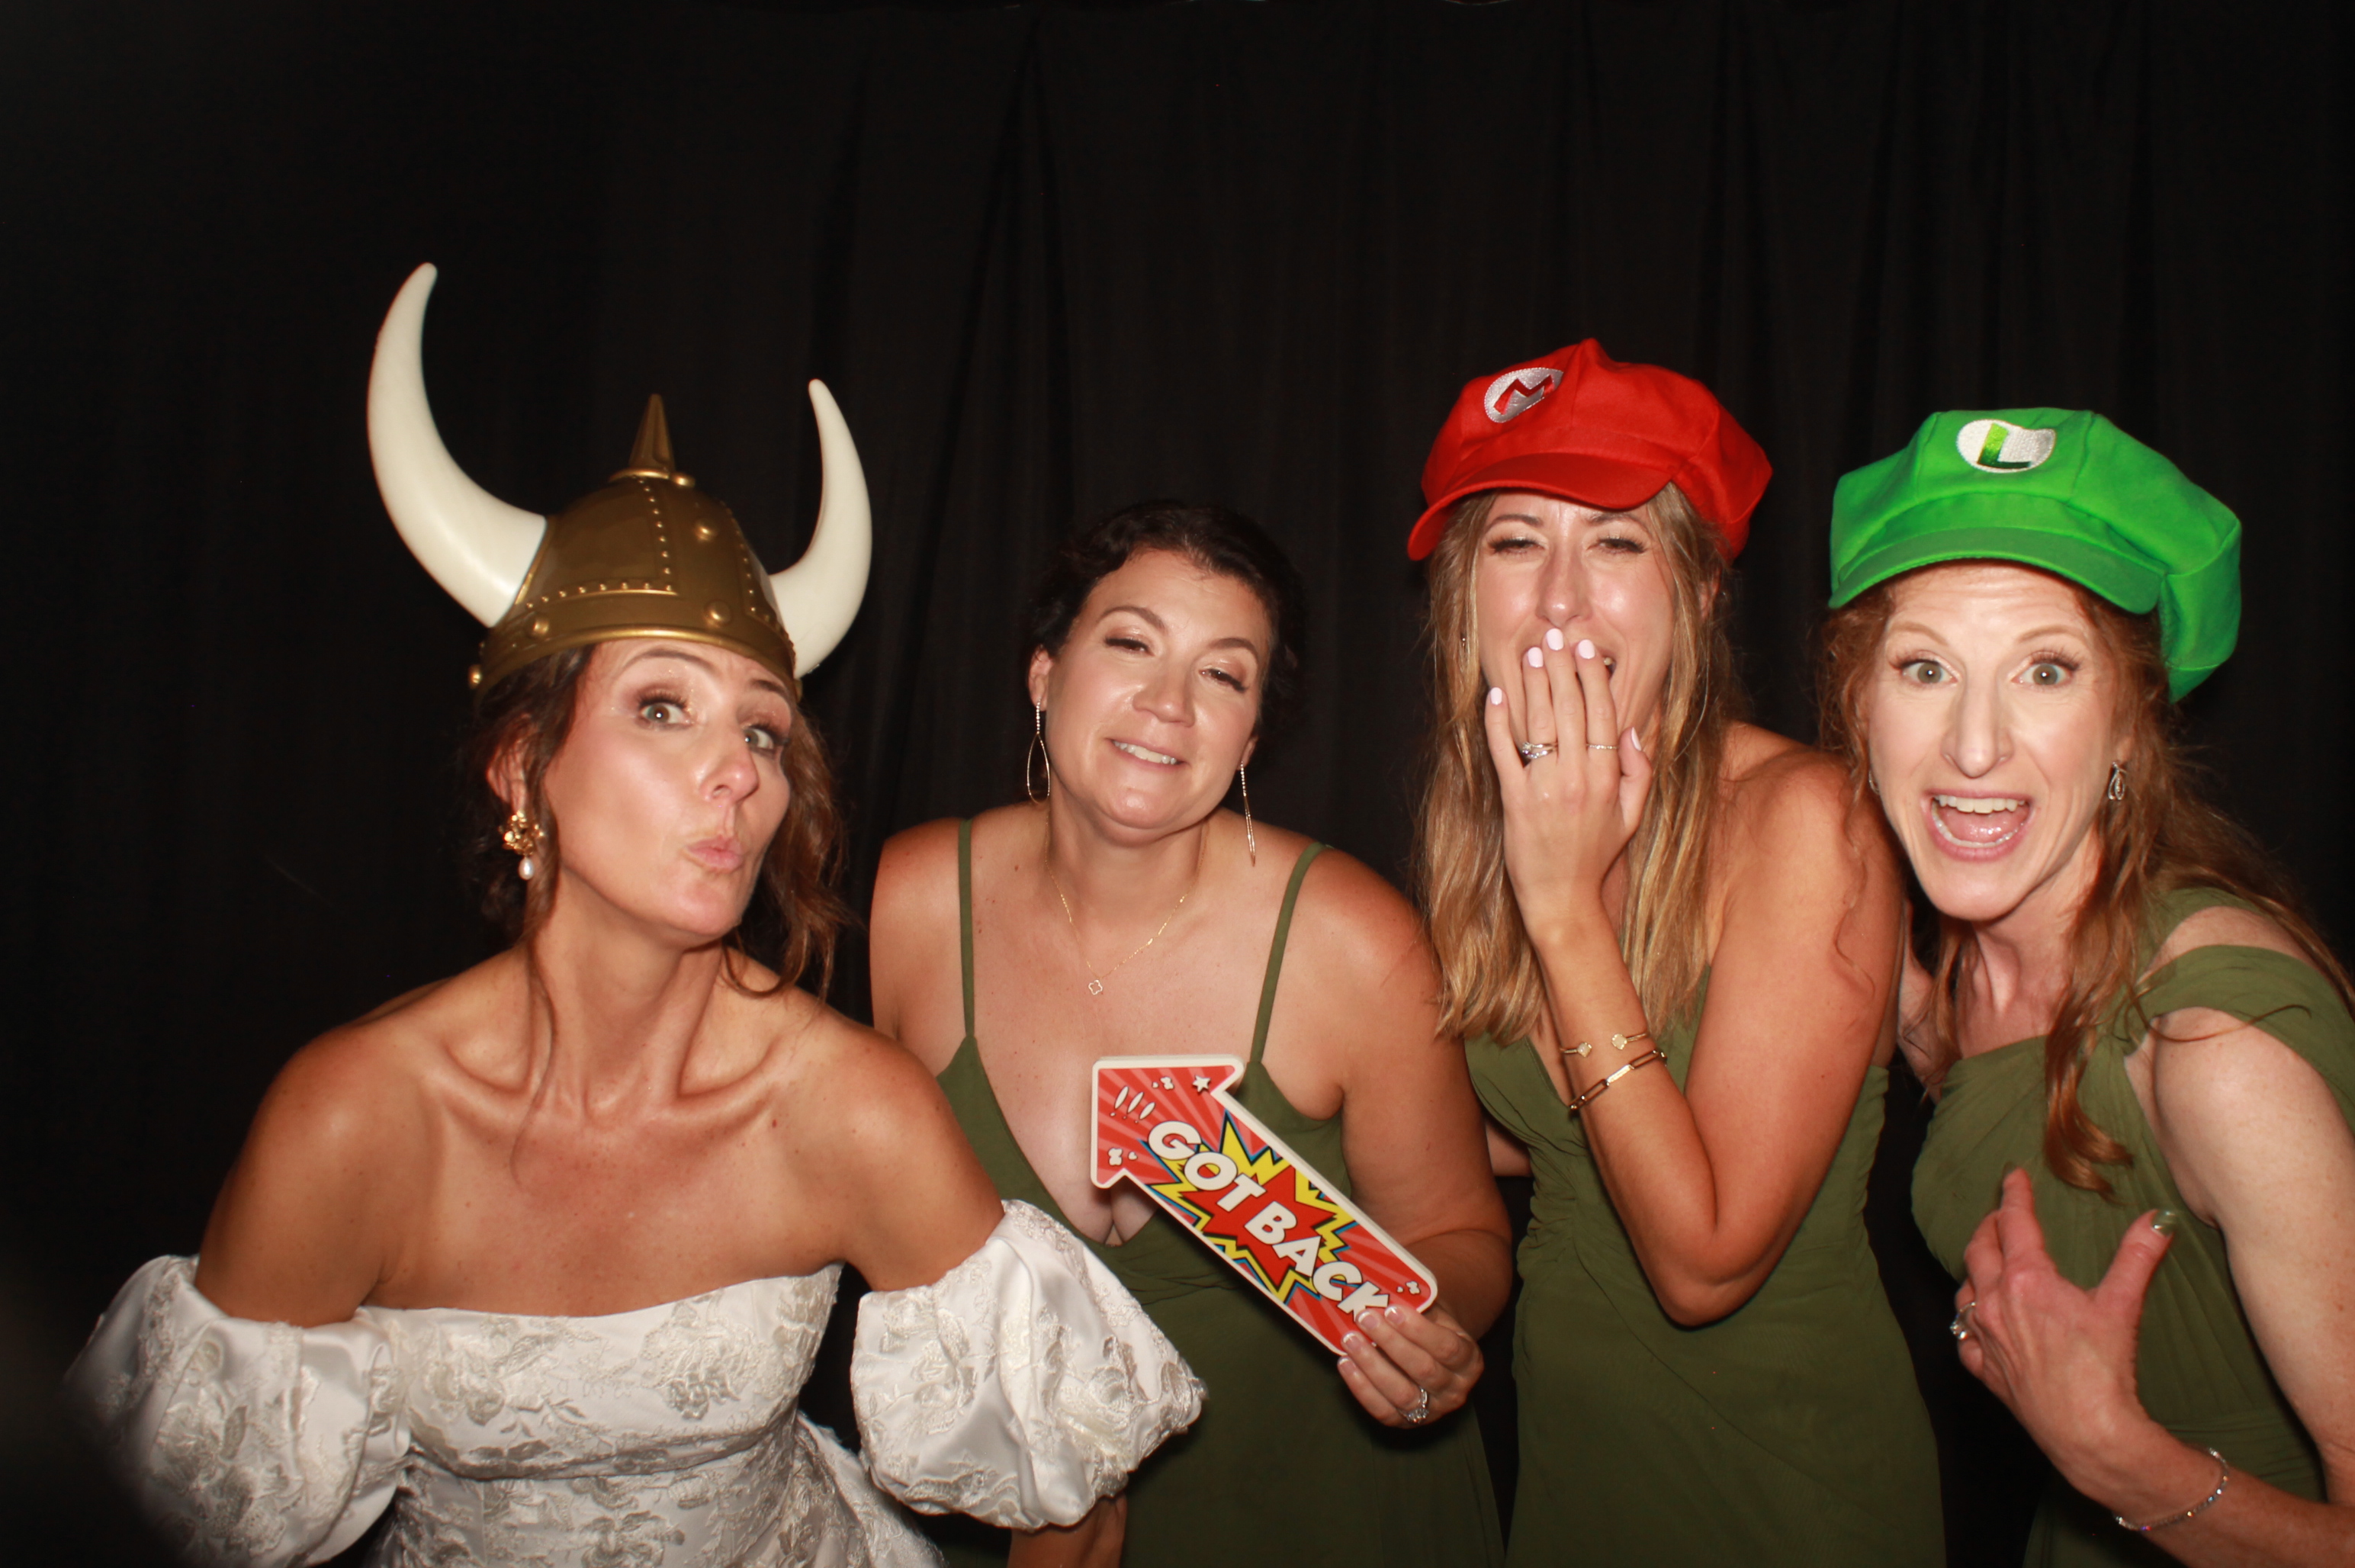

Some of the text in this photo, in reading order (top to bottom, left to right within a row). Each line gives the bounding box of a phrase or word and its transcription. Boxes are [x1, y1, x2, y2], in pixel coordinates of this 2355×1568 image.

[1493, 374, 1556, 416] M
[1977, 423, 2032, 469] L
[1148, 1120, 1389, 1322] GOT BACK
